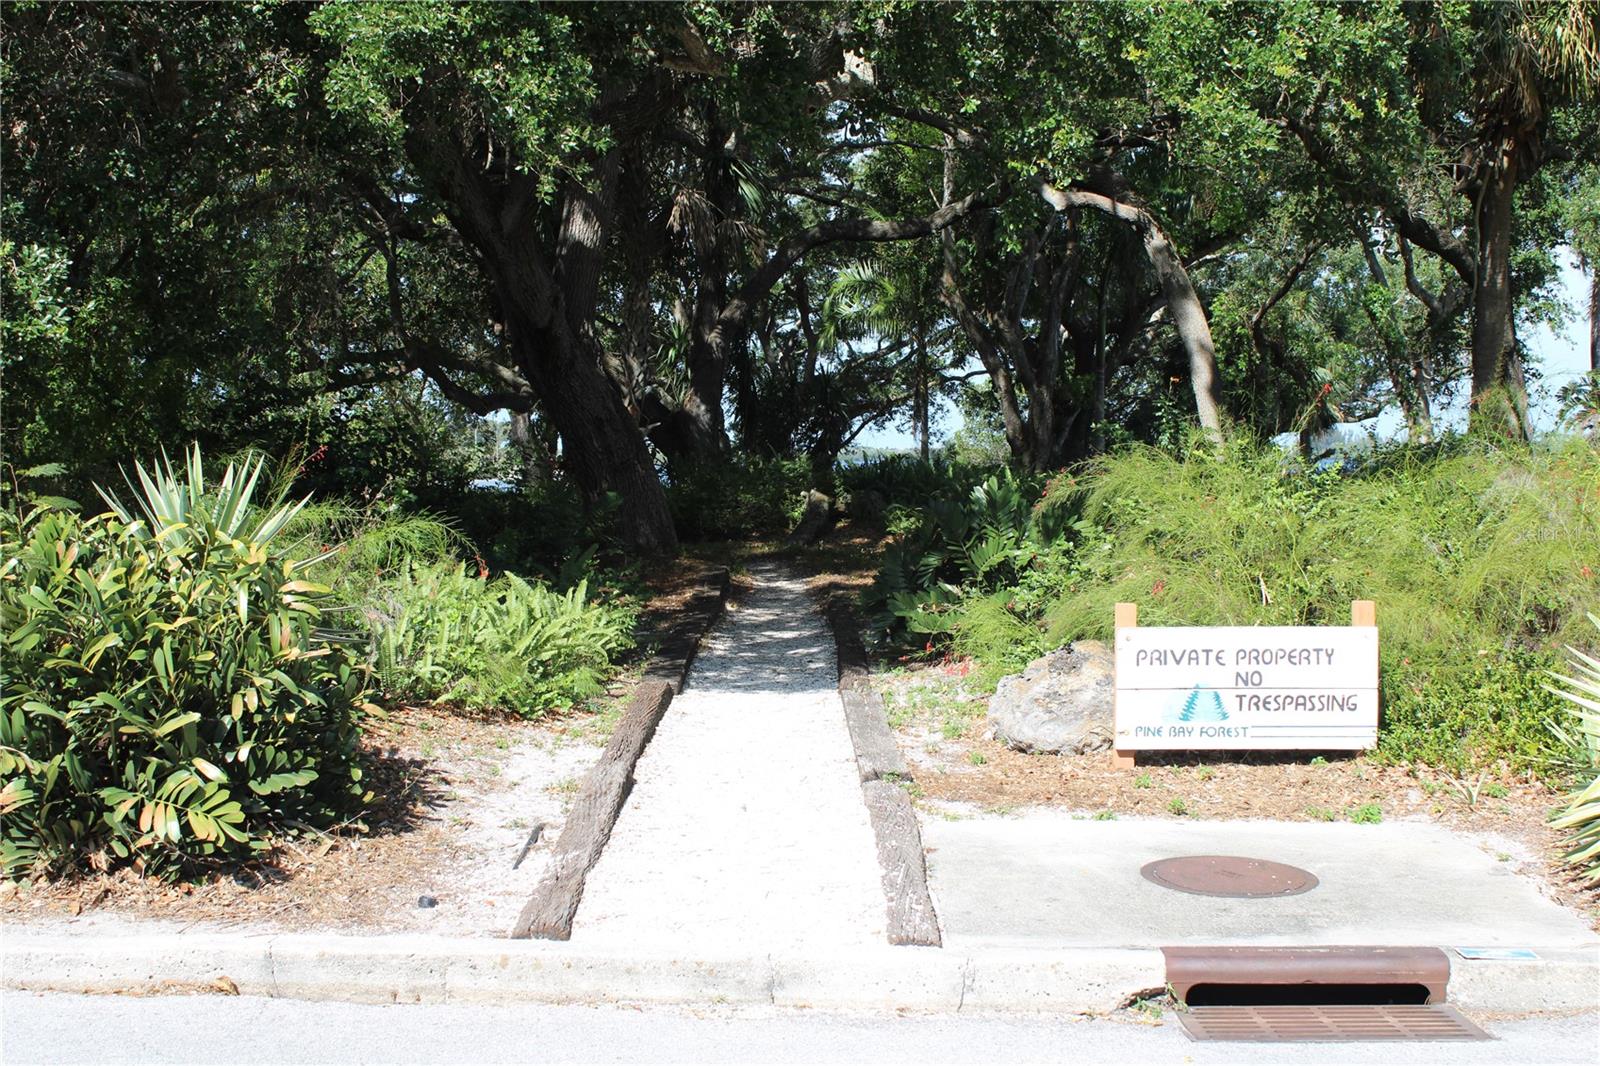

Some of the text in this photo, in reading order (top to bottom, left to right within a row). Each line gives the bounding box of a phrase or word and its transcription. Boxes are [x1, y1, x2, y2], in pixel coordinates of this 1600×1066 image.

[1136, 648, 1334, 666] PRIVATE PROPERTY
[1235, 670, 1262, 687] NO
[1236, 695, 1357, 711] TRESPASSING
[1136, 726, 1248, 738] PINE BAY FOREST
